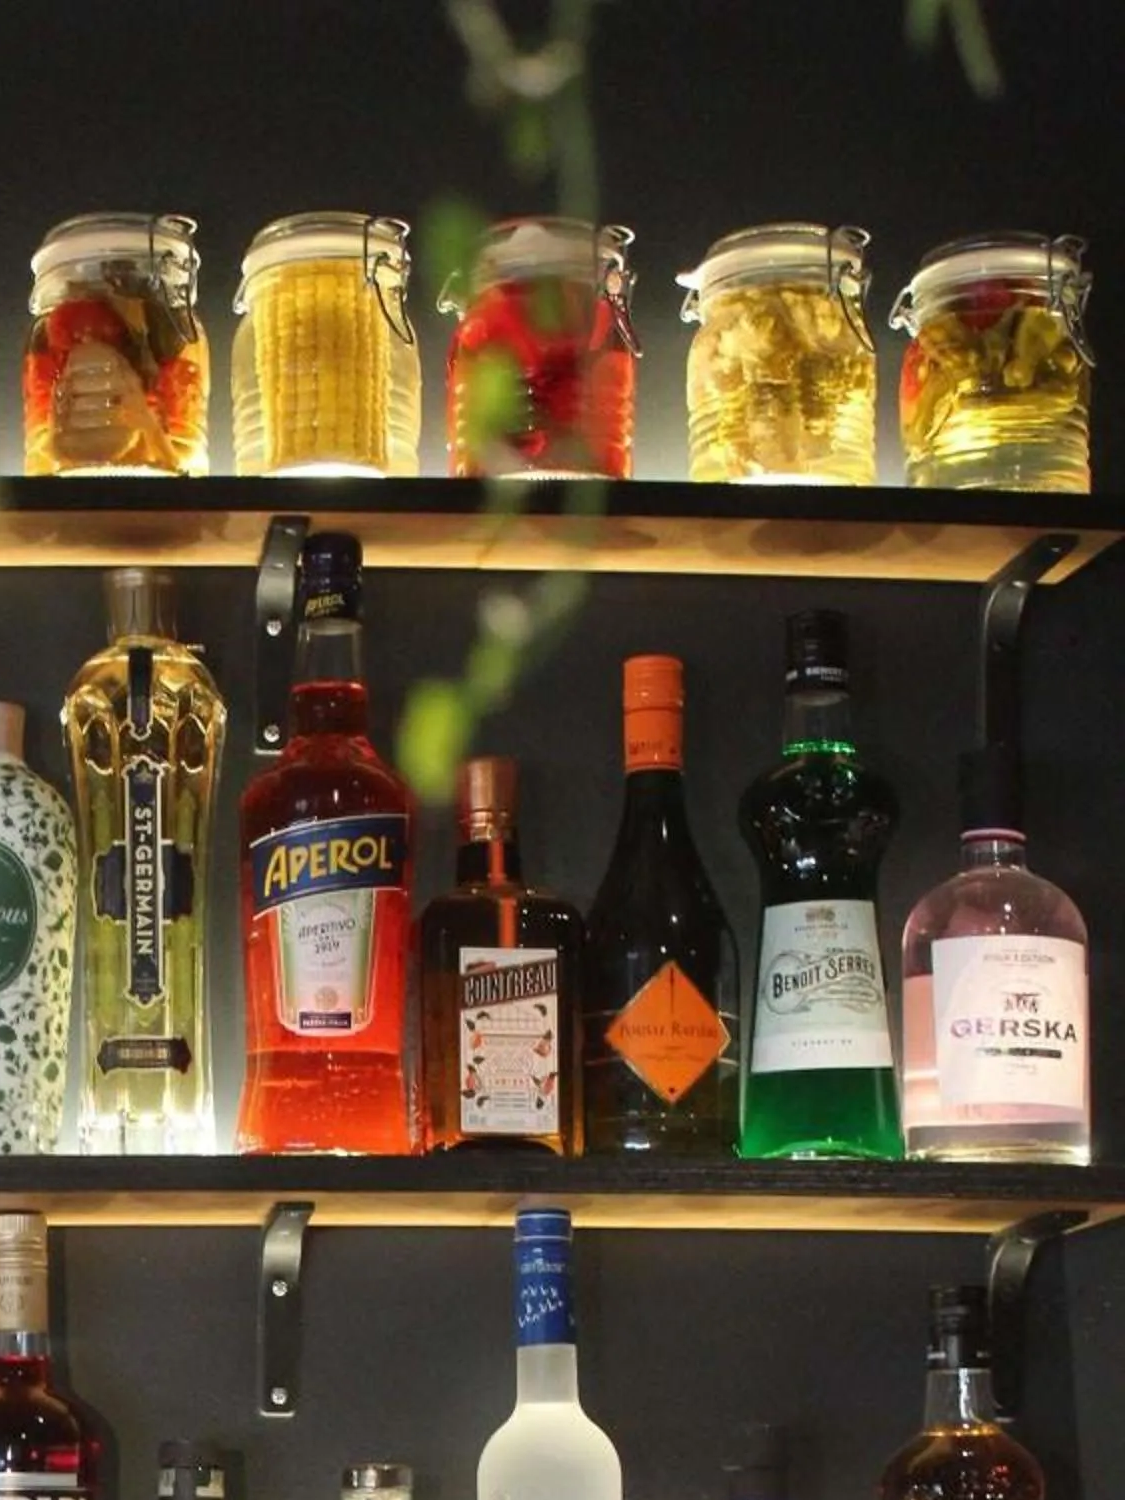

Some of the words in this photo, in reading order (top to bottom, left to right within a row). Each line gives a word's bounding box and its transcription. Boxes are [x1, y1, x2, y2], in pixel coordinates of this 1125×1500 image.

[135, 807, 154, 955] ST-GERMAIN
[264, 835, 392, 897] APEROL
[465, 962, 557, 1007] COINTREAU
[773, 966, 821, 998] BENOIT
[951, 1019, 1077, 1042] GERSKA
